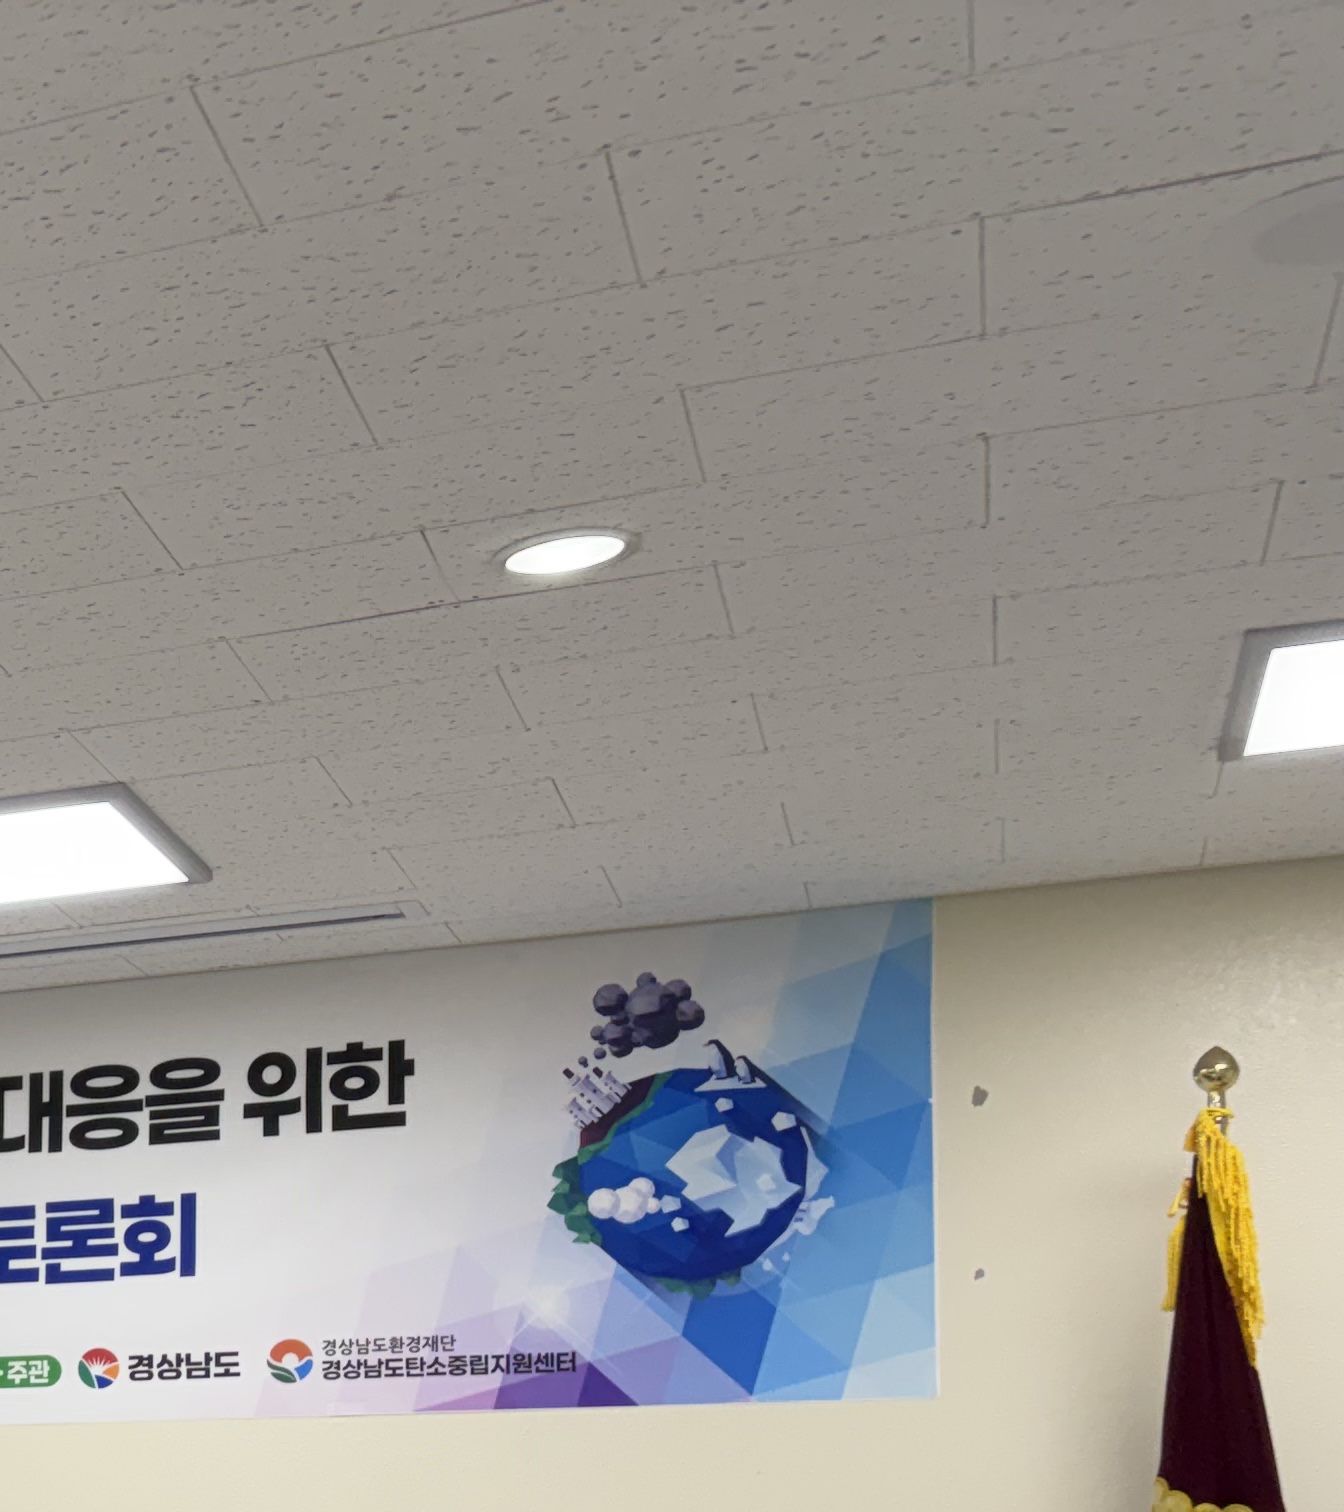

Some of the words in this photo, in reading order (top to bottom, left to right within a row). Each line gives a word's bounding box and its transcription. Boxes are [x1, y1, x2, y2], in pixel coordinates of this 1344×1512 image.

[242, 1039, 415, 1136] 위한
[321, 1334, 456, 1357] 경상남도환경재단
[128, 1350, 241, 1381] 경상남도
[321, 1351, 577, 1381] 경상남도탄소중립지원센터
